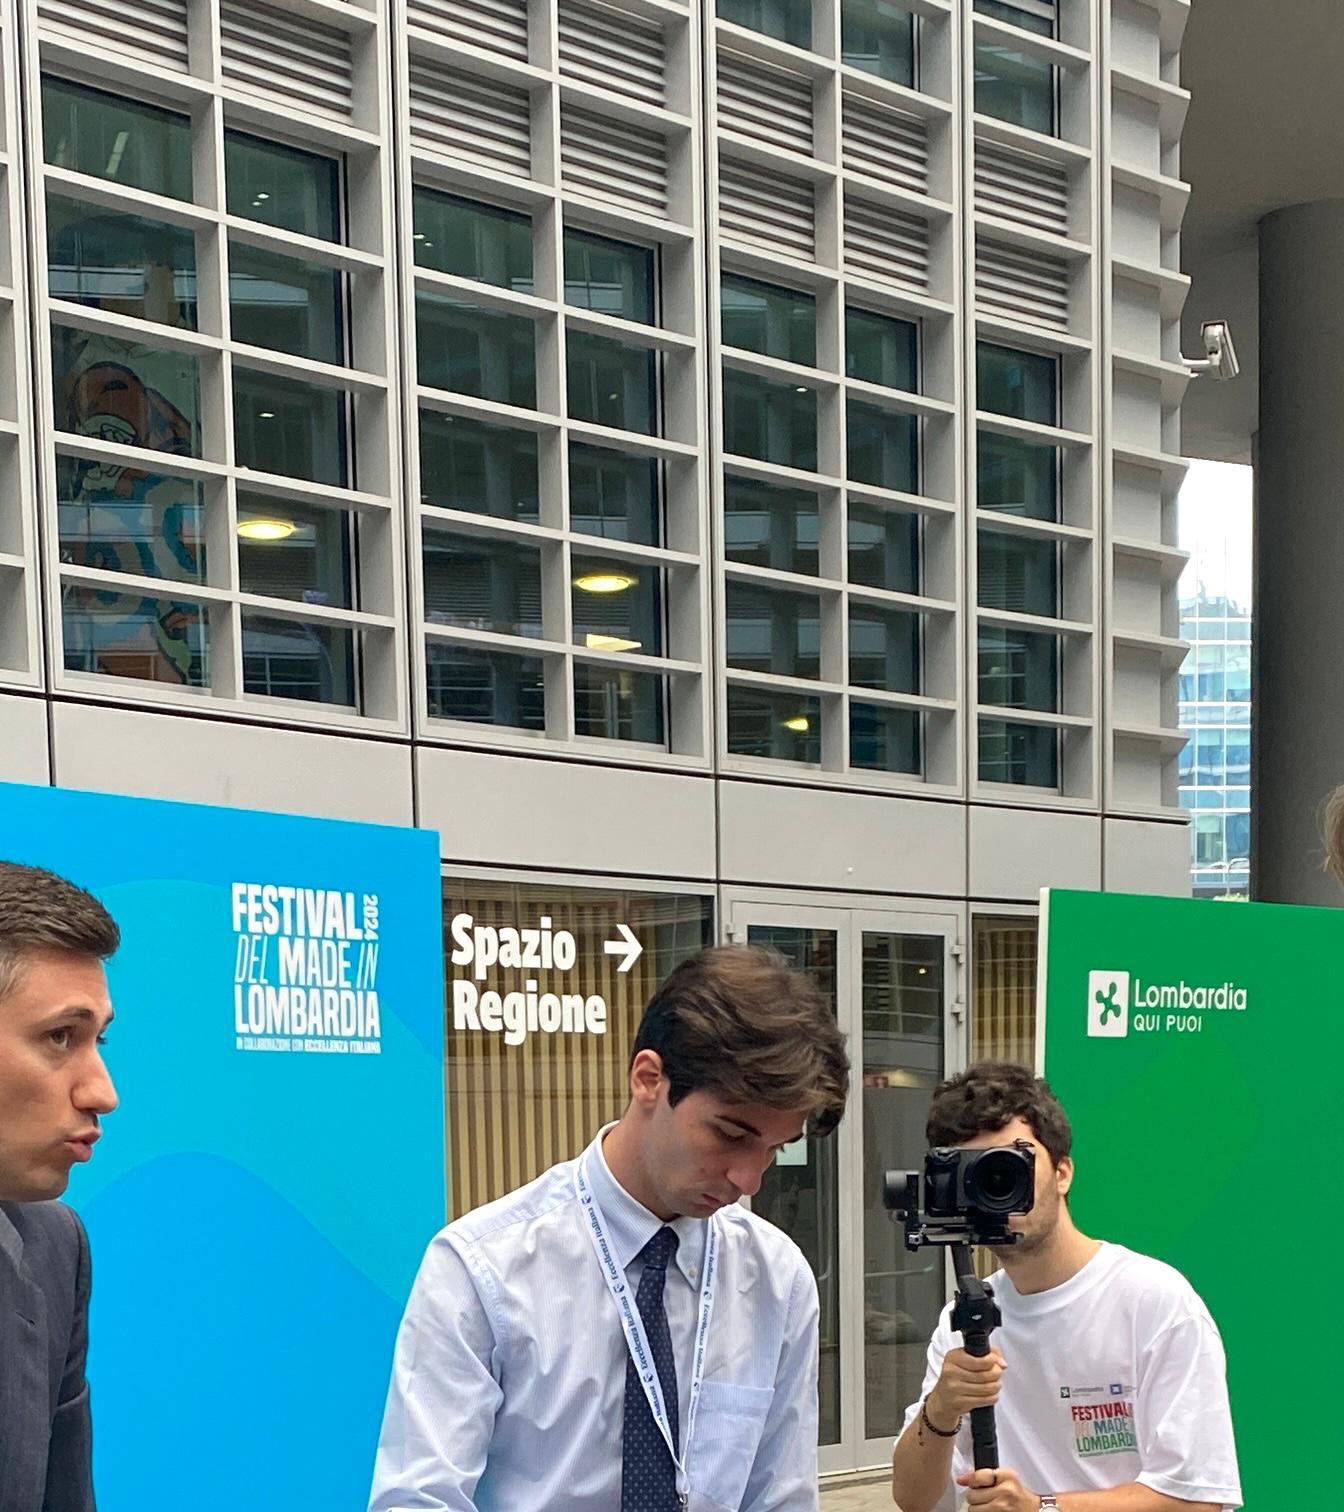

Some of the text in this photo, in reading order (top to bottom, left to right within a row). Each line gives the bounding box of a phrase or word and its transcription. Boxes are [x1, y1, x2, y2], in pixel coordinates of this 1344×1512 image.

[232, 882, 363, 940] FESTIVAL
[363, 894, 379, 941] 2024
[235, 934, 379, 990] DEL MADE IN
[451, 912, 576, 980] Spazio
[234, 984, 381, 1038] LOMBARDIA
[453, 980, 607, 1046] Regione
[1135, 978, 1247, 1011] Lombardia
[1134, 1013, 1202, 1033] QUI PUOI
[1071, 1401, 1129, 1421] FESTIVAL
[1094, 1417, 1129, 1435] MADE
